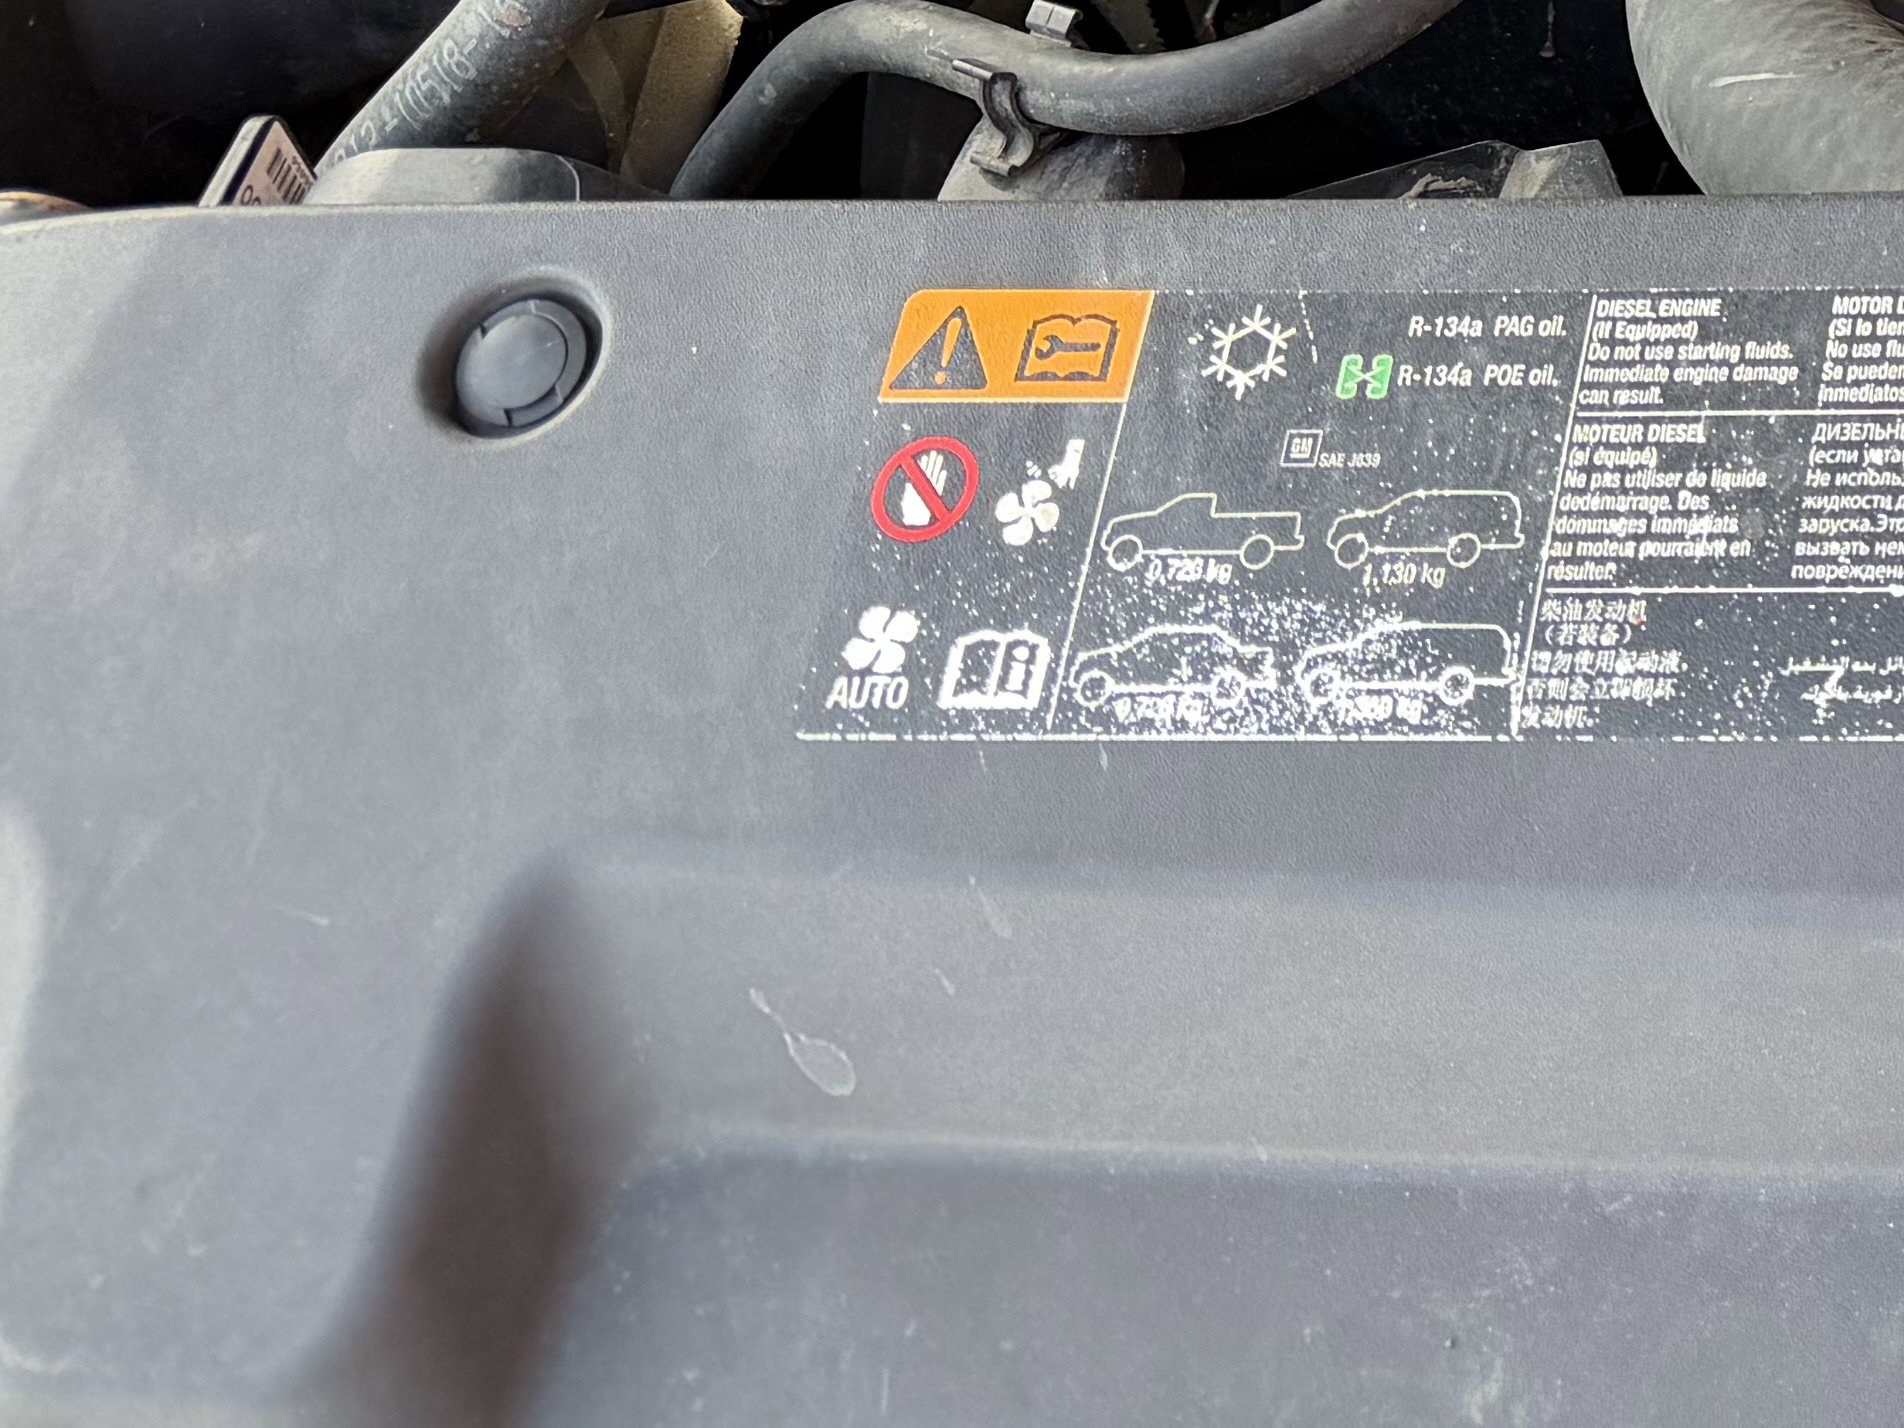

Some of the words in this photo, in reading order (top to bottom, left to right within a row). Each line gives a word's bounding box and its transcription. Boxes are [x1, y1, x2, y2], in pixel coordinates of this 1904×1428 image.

[1597, 299, 1656, 318] DIESEL
[1659, 298, 1722, 317] ENGINE
[1832, 296, 1893, 315] MOTOR
[1408, 315, 1483, 337] R-134a
[1494, 315, 1534, 337] PAG
[1538, 315, 1567, 337] oil.
[1592, 321, 1612, 341] (If
[1615, 320, 1698, 342] Equipped)
[1829, 318, 1851, 338] (Si
[1856, 318, 1872, 336] lo
[1588, 344, 1610, 361] Do
[1614, 344, 1641, 361] not
[1644, 347, 1674, 361] use
[1678, 343, 1741, 363] starting
[1745, 341, 1793, 359] fluids.
[1826, 340, 1847, 358] No
[1852, 344, 1882, 358] use
[1398, 363, 1472, 387] R-134a
[1483, 364, 1525, 387] POE
[1529, 364, 1558, 387] oil.
[1584, 364, 1669, 382] Immediate
[1673, 366, 1729, 385] engine
[1732, 364, 1799, 384] damage
[1822, 361, 1843, 380] Se
[1579, 390, 1609, 404] can
[1613, 386, 1664, 404] result.
[1572, 424, 1644, 443] MOTEUR
[1648, 423, 1706, 443] DIESEL
[1319, 452, 1344, 468] SAE
[1569, 447, 1590, 468] (si
[1593, 446, 1658, 468] équipé)
[1809, 445, 1857, 466] (если
[1564, 470, 1587, 488] Ne
[1590, 473, 1620, 490] pas
[1625, 469, 1683, 489] utiliser
[1686, 471, 1707, 487] de
[1710, 469, 1767, 491] liquide
[1806, 470, 1830, 487] Не
[1678, 490, 1710, 510] Des
[1801, 495, 1892, 513] жидкости
[1550, 541, 1572, 557] au
[1576, 540, 1637, 557] moteur
[1730, 540, 1751, 556] en
[1795, 542, 1870, 556] вызвать
[1421, 562, 1446, 589] kg
[824, 675, 909, 710] AUTO
